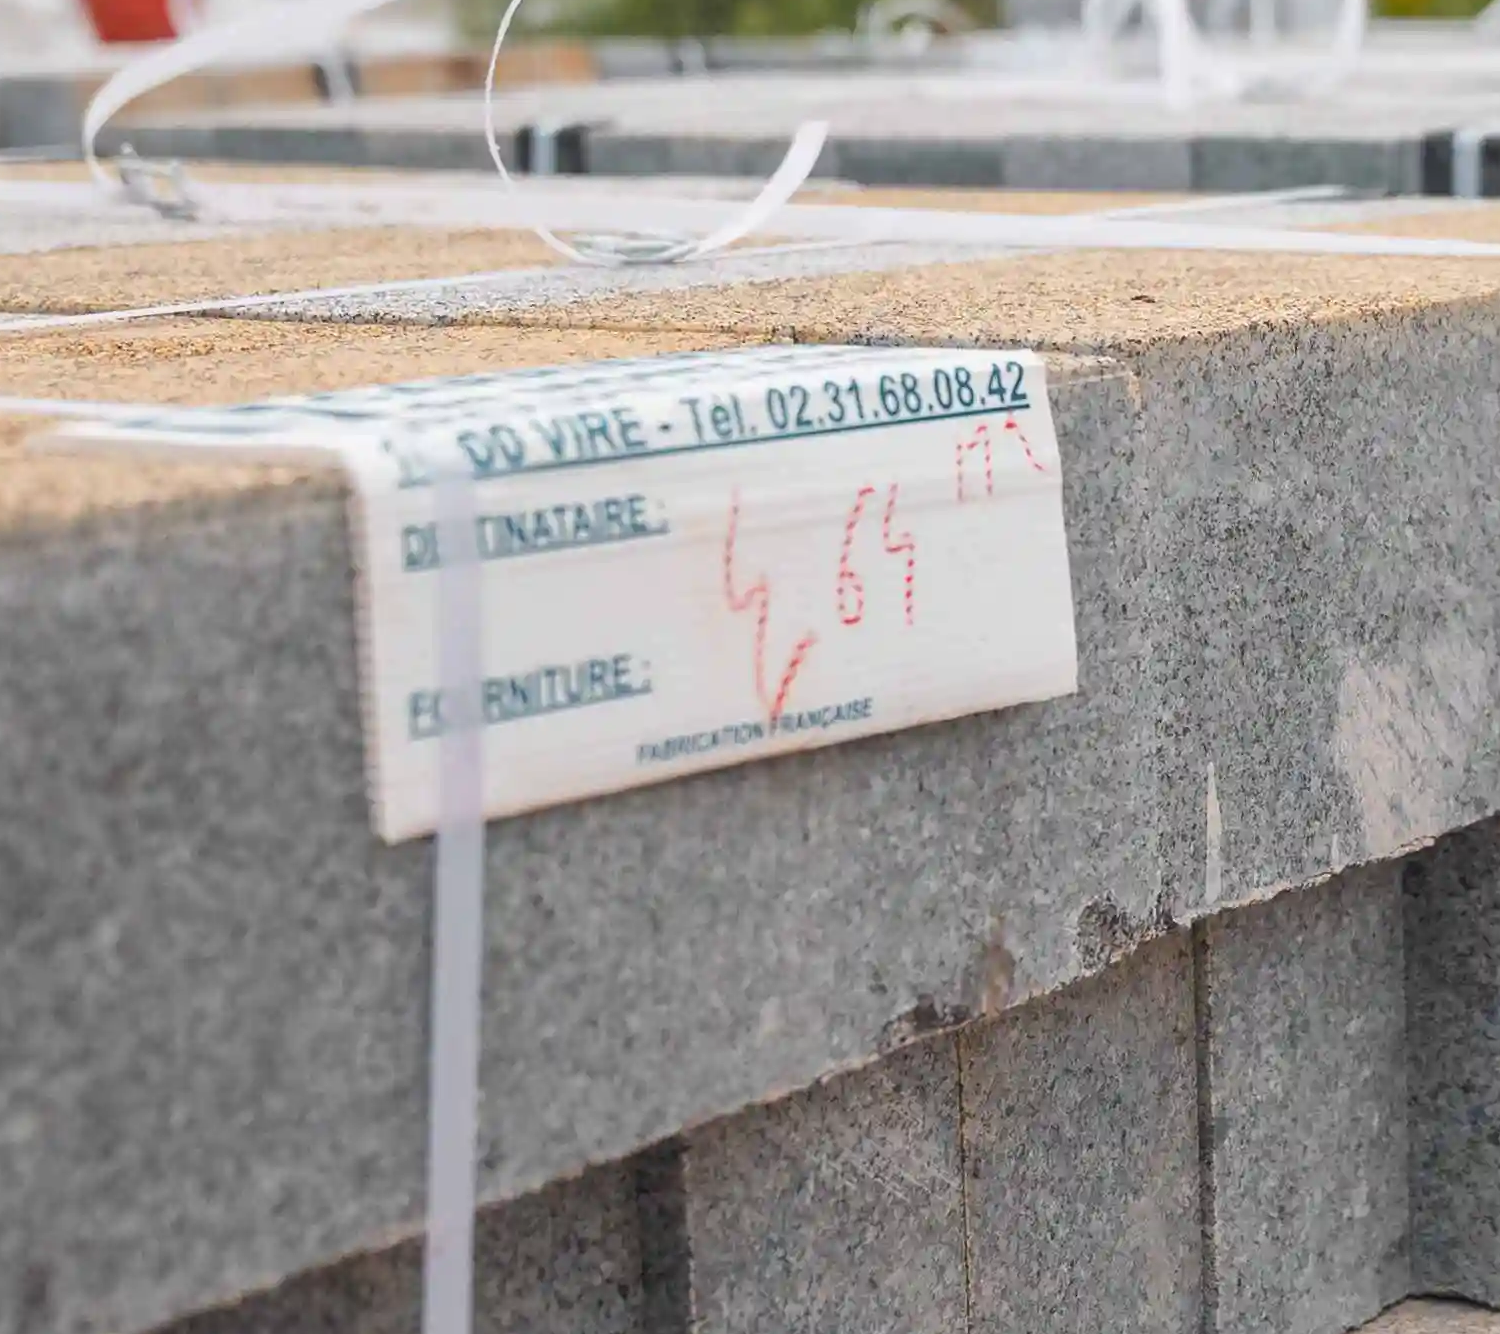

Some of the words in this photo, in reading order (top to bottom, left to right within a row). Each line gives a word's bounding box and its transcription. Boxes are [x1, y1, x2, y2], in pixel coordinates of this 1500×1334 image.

[528, 407, 648, 462] VIRE
[766, 360, 1028, 432] 02.31.68.08.42
[636, 720, 764, 763] FABRICATION
